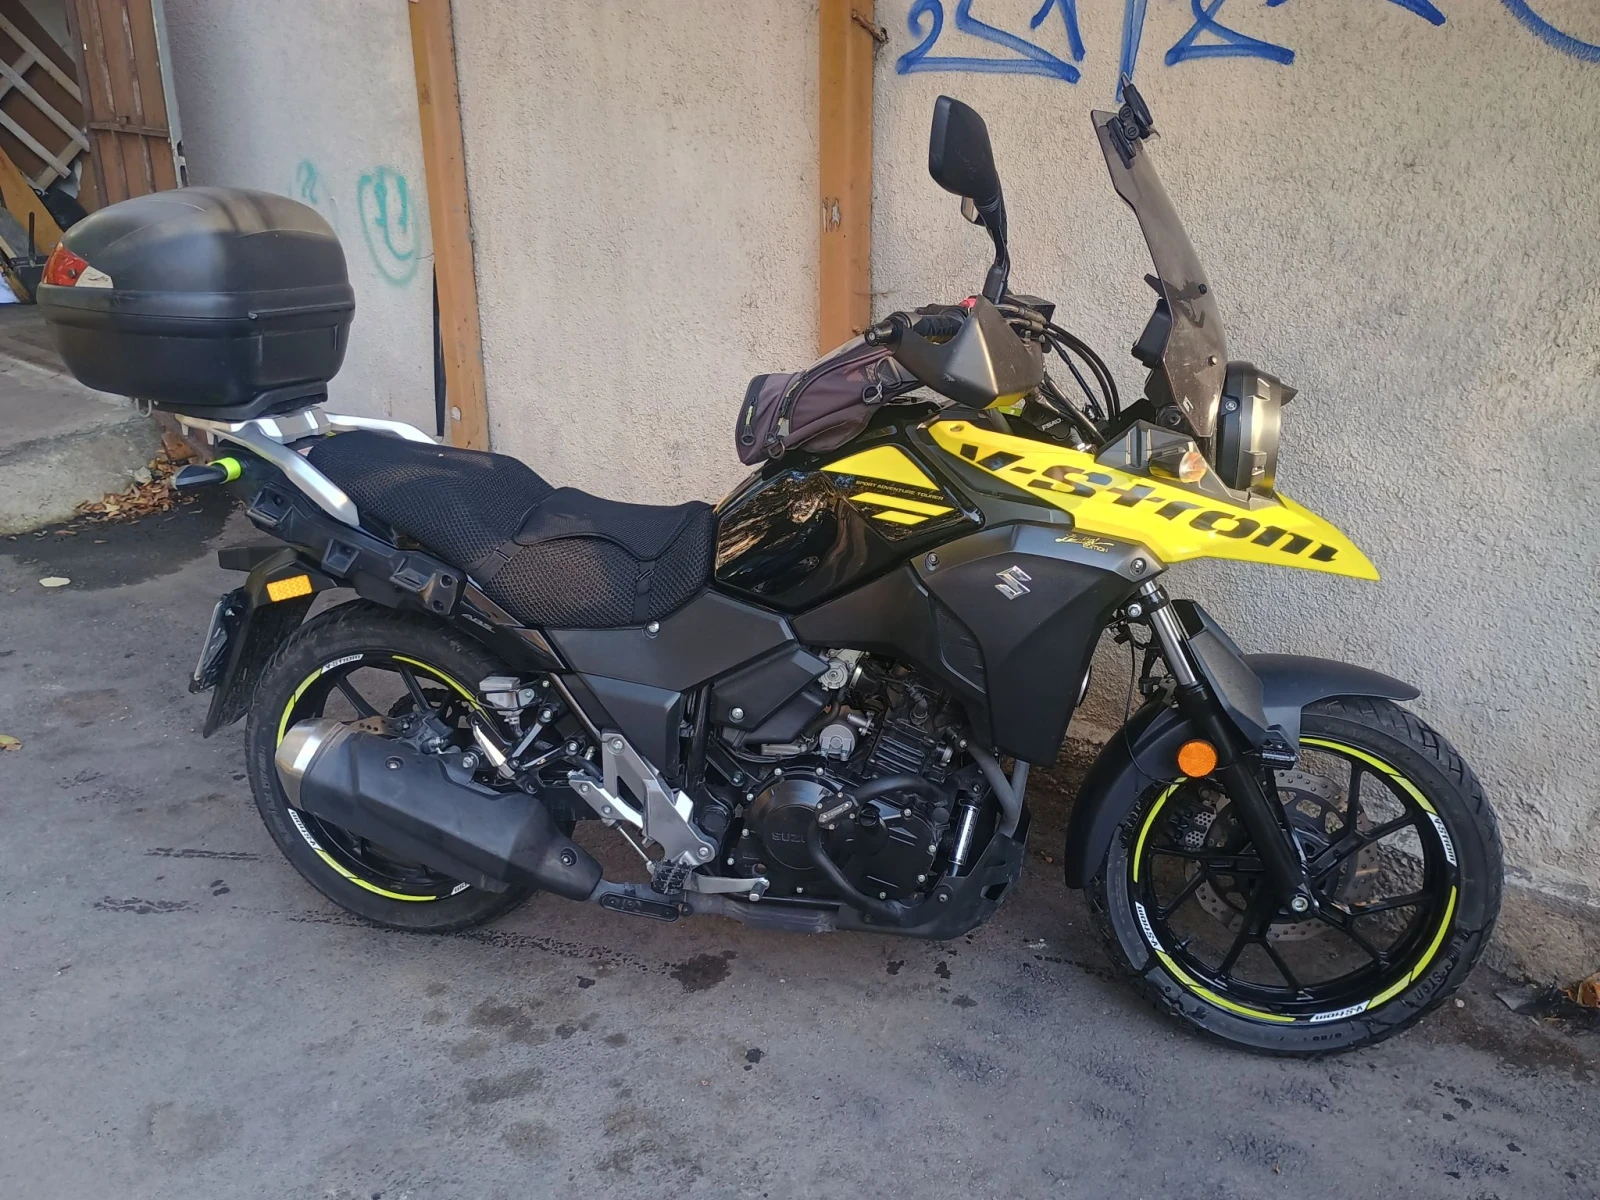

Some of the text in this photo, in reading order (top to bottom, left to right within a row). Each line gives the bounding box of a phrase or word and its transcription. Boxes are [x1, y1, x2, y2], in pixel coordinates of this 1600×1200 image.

[855, 480, 944, 501] SPORT ADVENTURE TOURER
